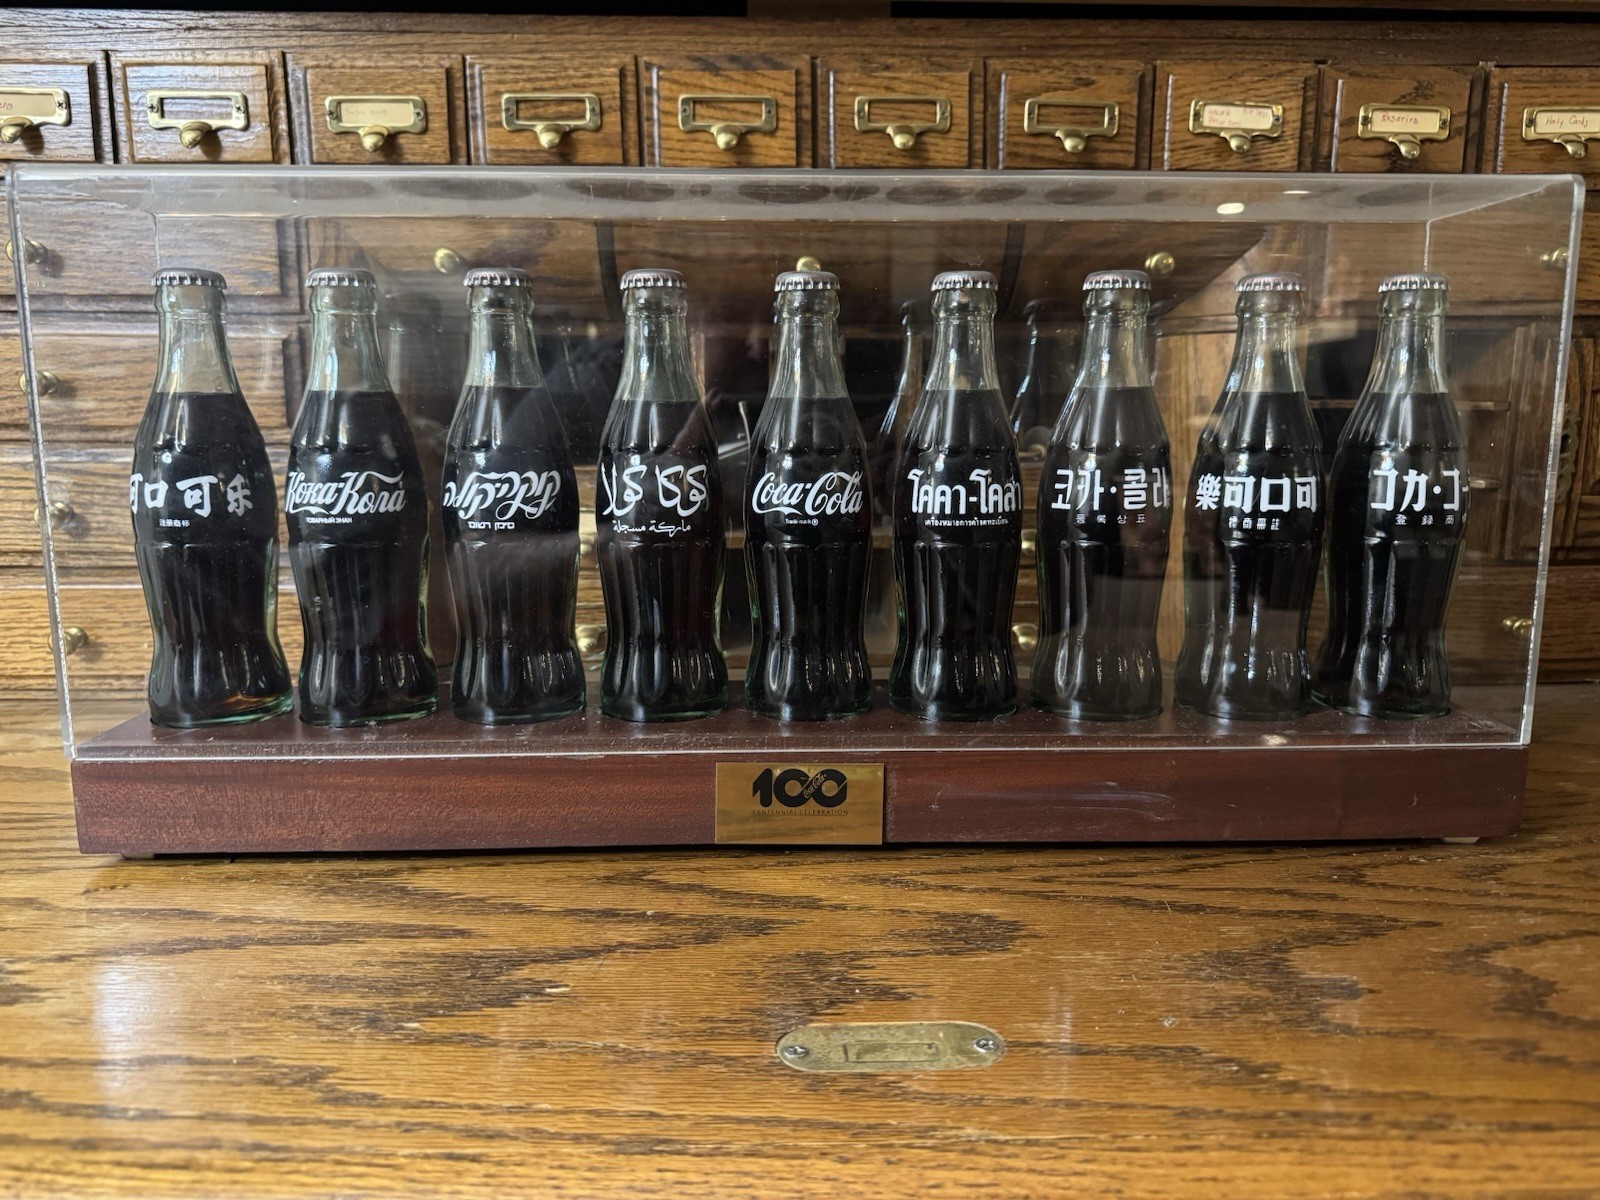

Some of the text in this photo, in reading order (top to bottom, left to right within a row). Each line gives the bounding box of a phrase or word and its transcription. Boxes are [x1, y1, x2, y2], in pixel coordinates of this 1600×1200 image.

[1381, 112, 1419, 125] Rosaries
[1545, 115, 1588, 128] Holy Cards
[751, 470, 864, 516] Coca-Cola
[752, 768, 848, 808] 100
